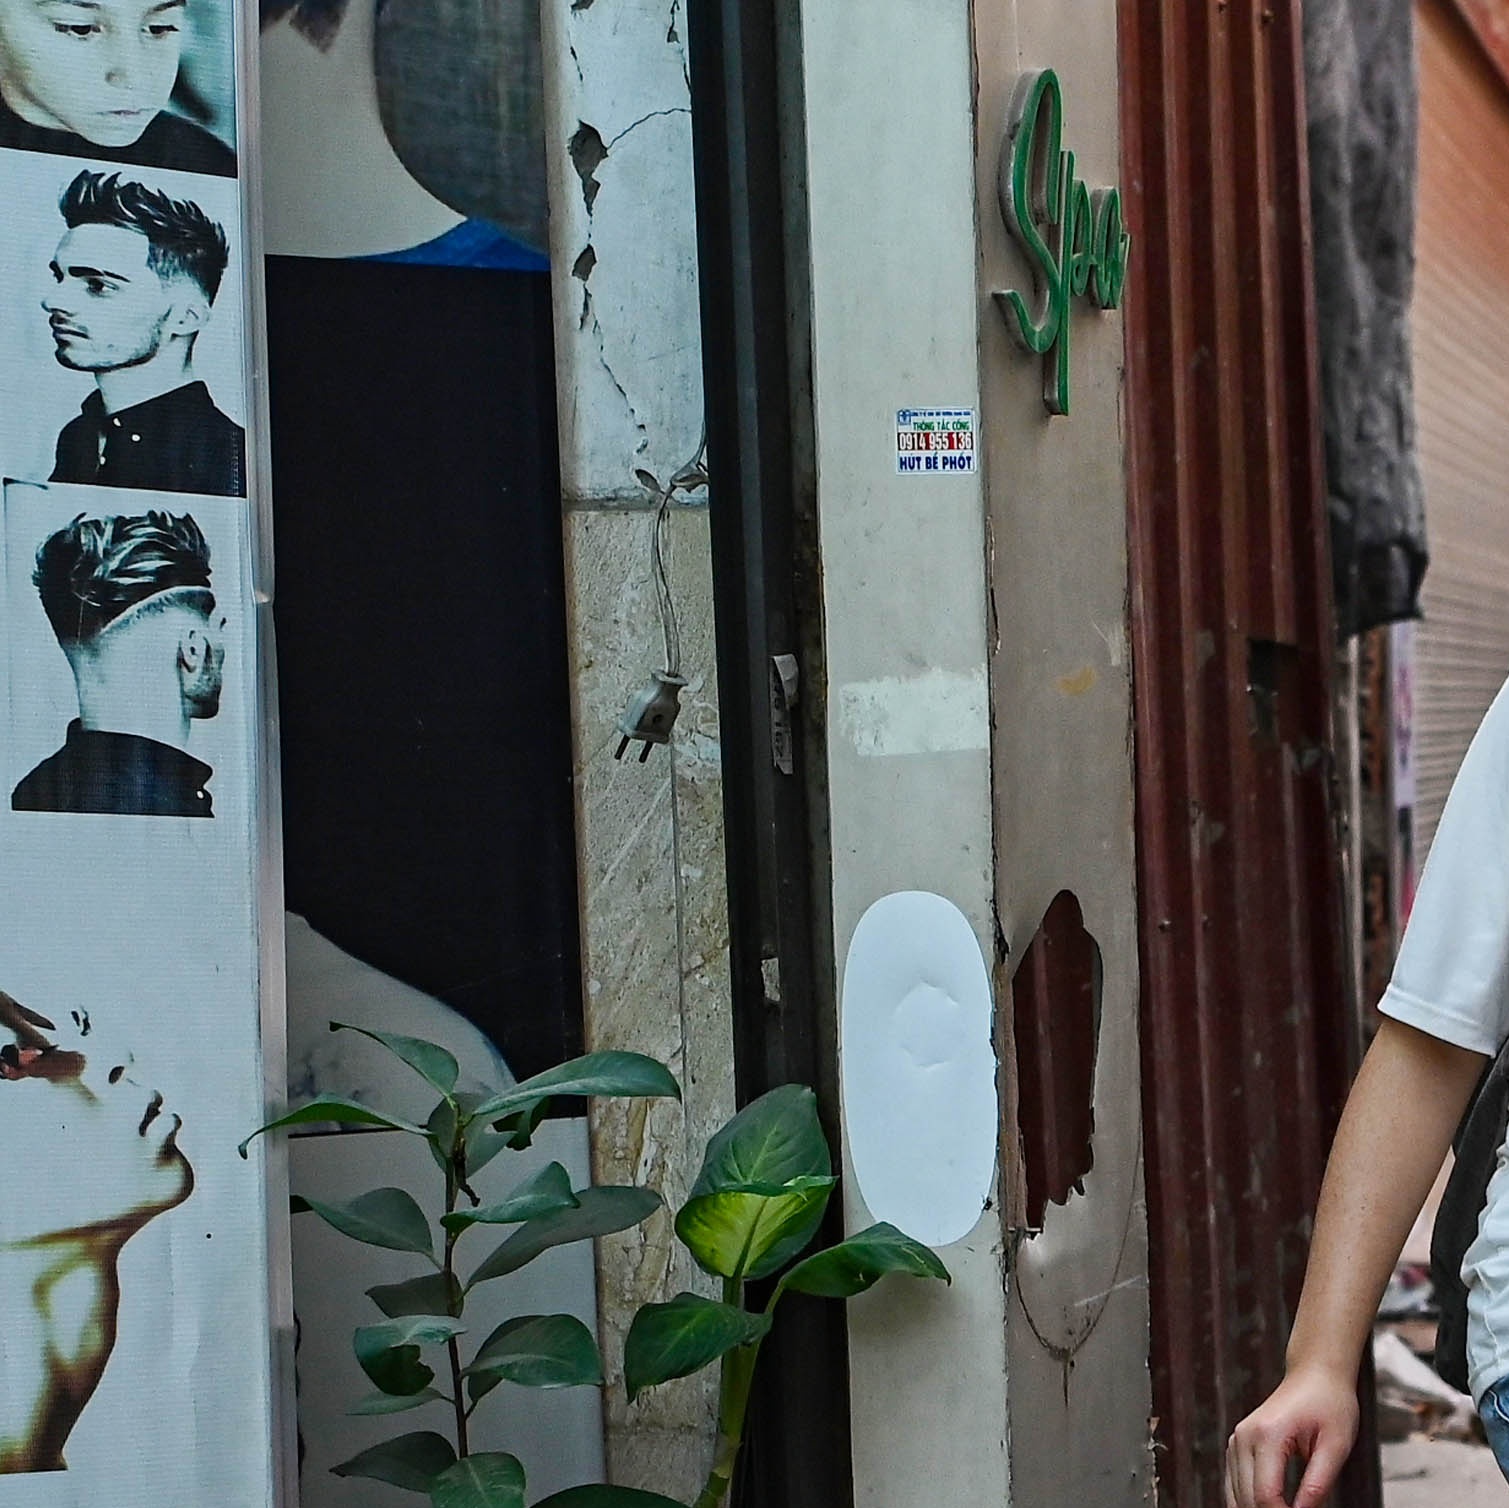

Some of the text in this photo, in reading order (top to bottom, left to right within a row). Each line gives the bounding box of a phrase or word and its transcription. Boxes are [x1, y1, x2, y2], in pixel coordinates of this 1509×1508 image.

[993, 67, 1131, 415] Spa
[899, 433, 972, 450] 0914 955 136
